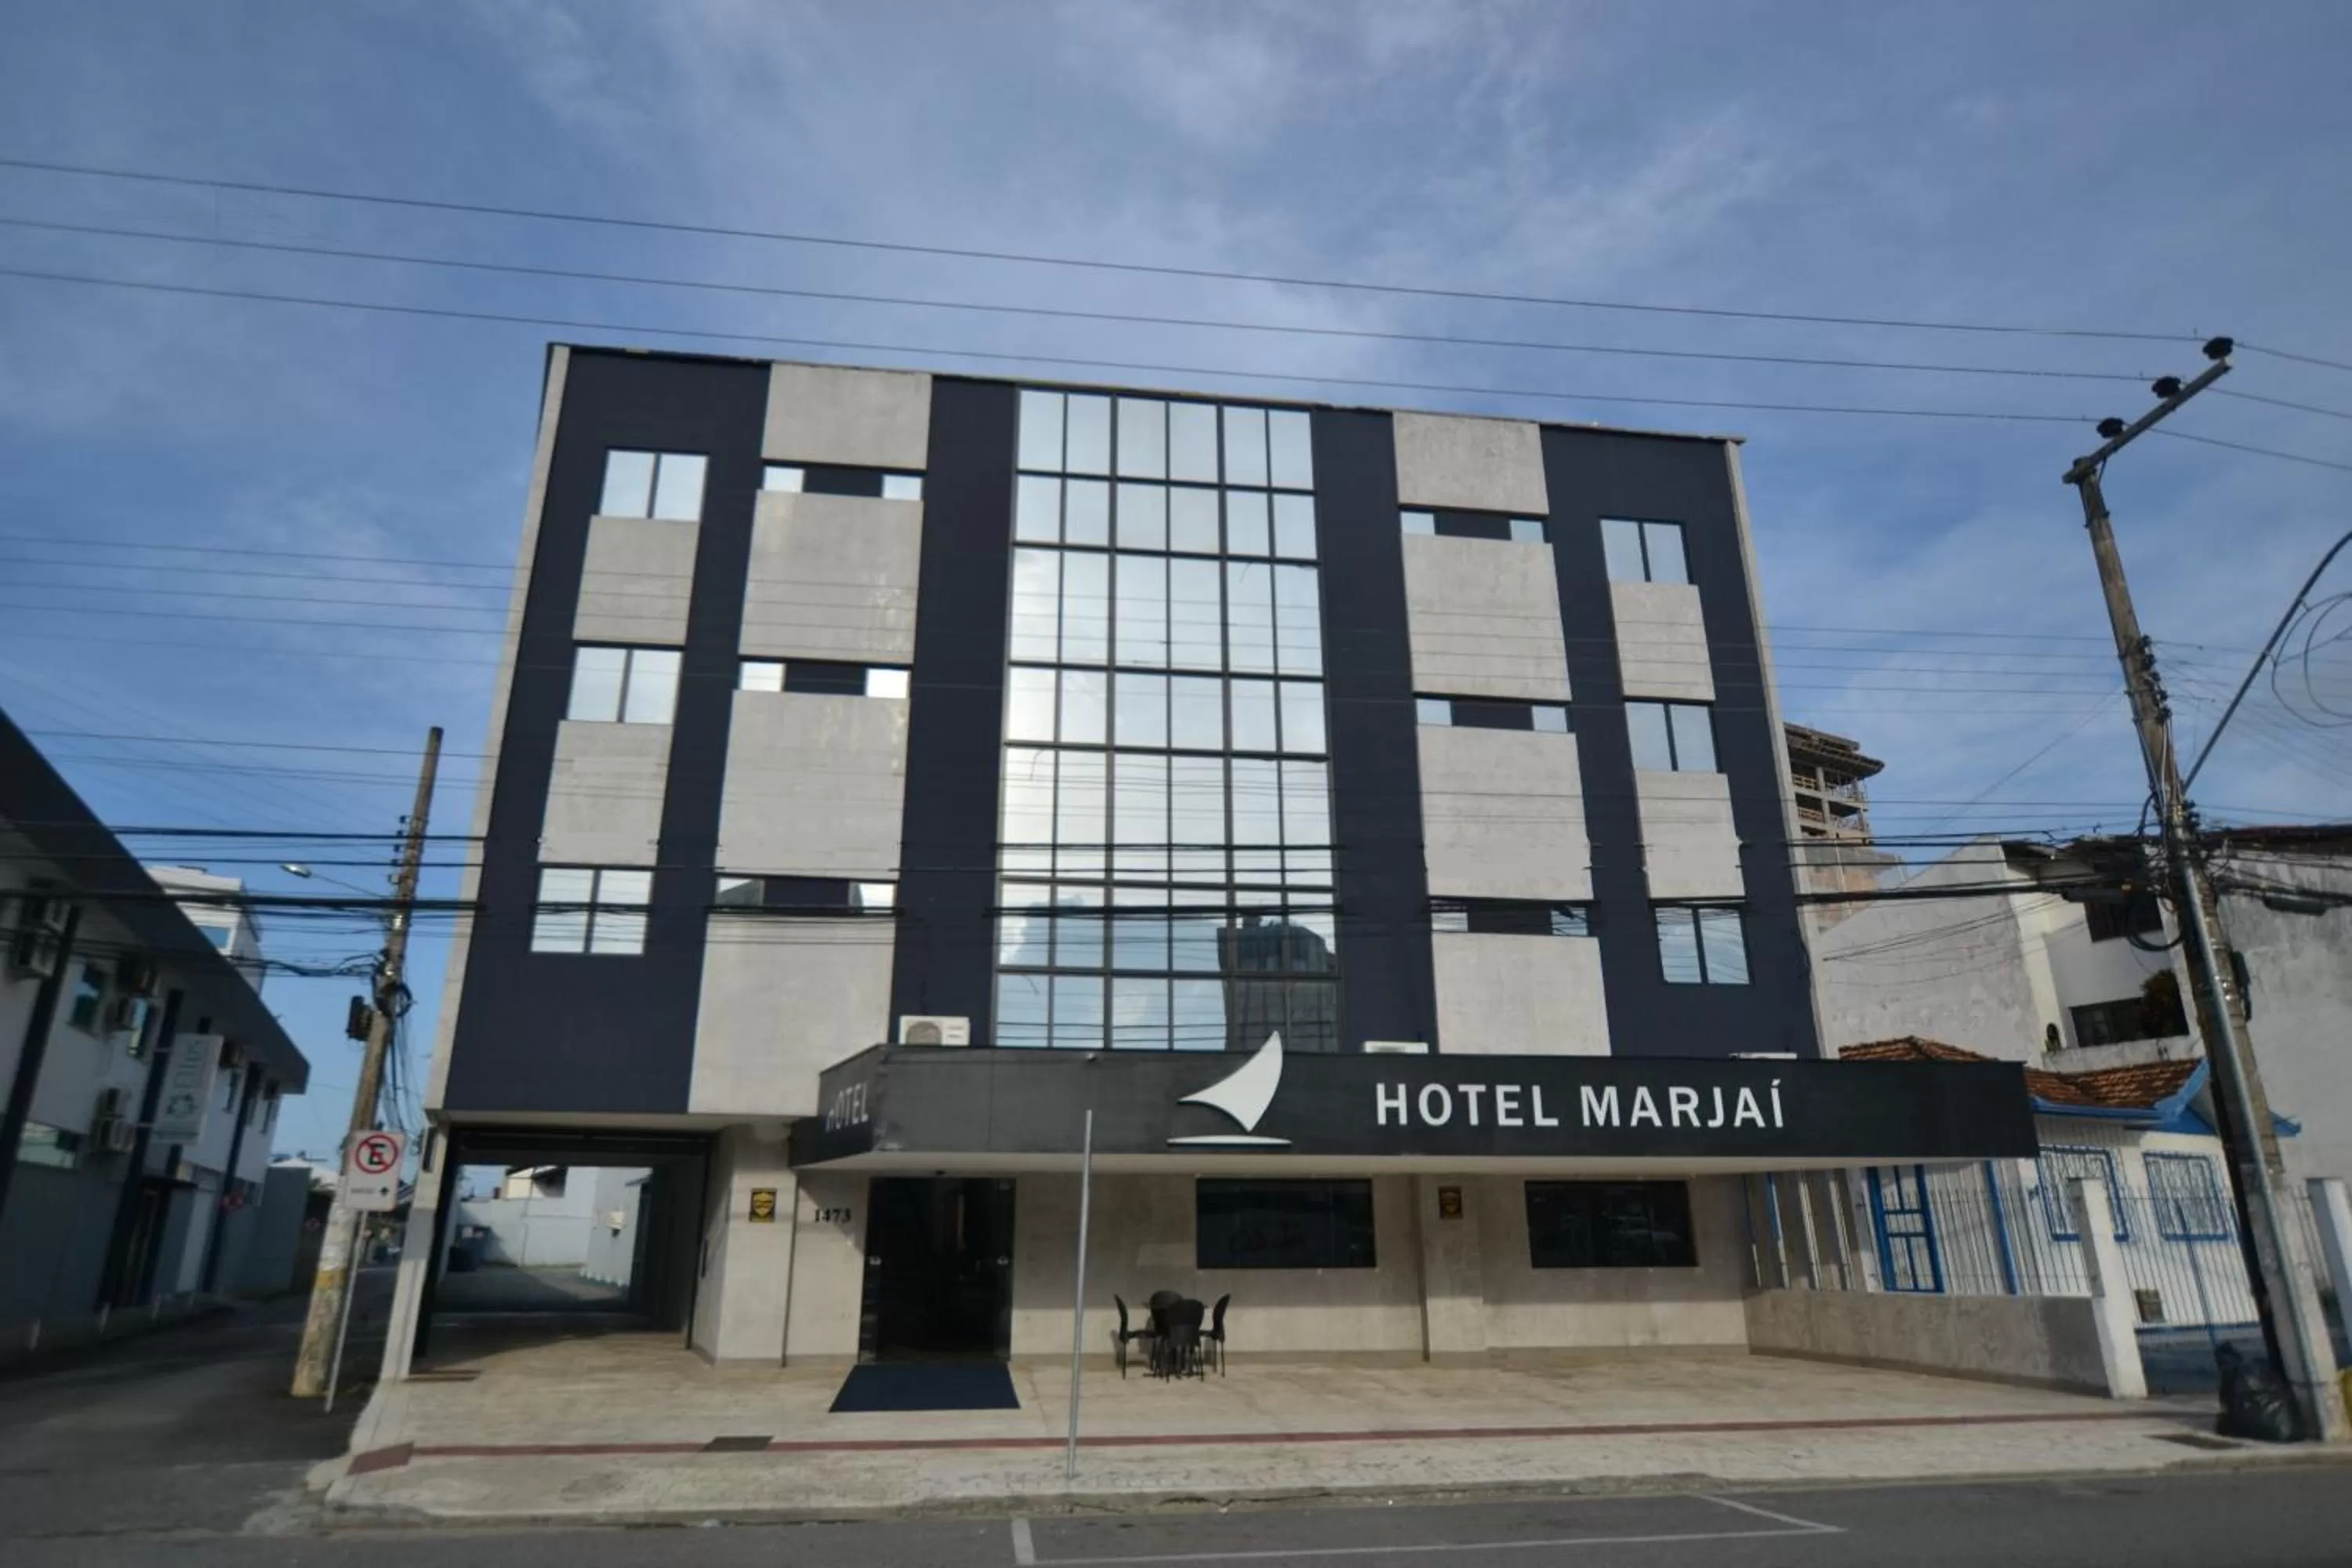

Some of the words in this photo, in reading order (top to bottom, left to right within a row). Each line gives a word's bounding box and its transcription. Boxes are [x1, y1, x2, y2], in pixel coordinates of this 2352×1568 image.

[825, 1081, 869, 1132] HOTEL
[1375, 1082, 1559, 1127] HOTEL
[1579, 1078, 1784, 1129] MARJAÍ
[814, 1207, 851, 1223] 1473
